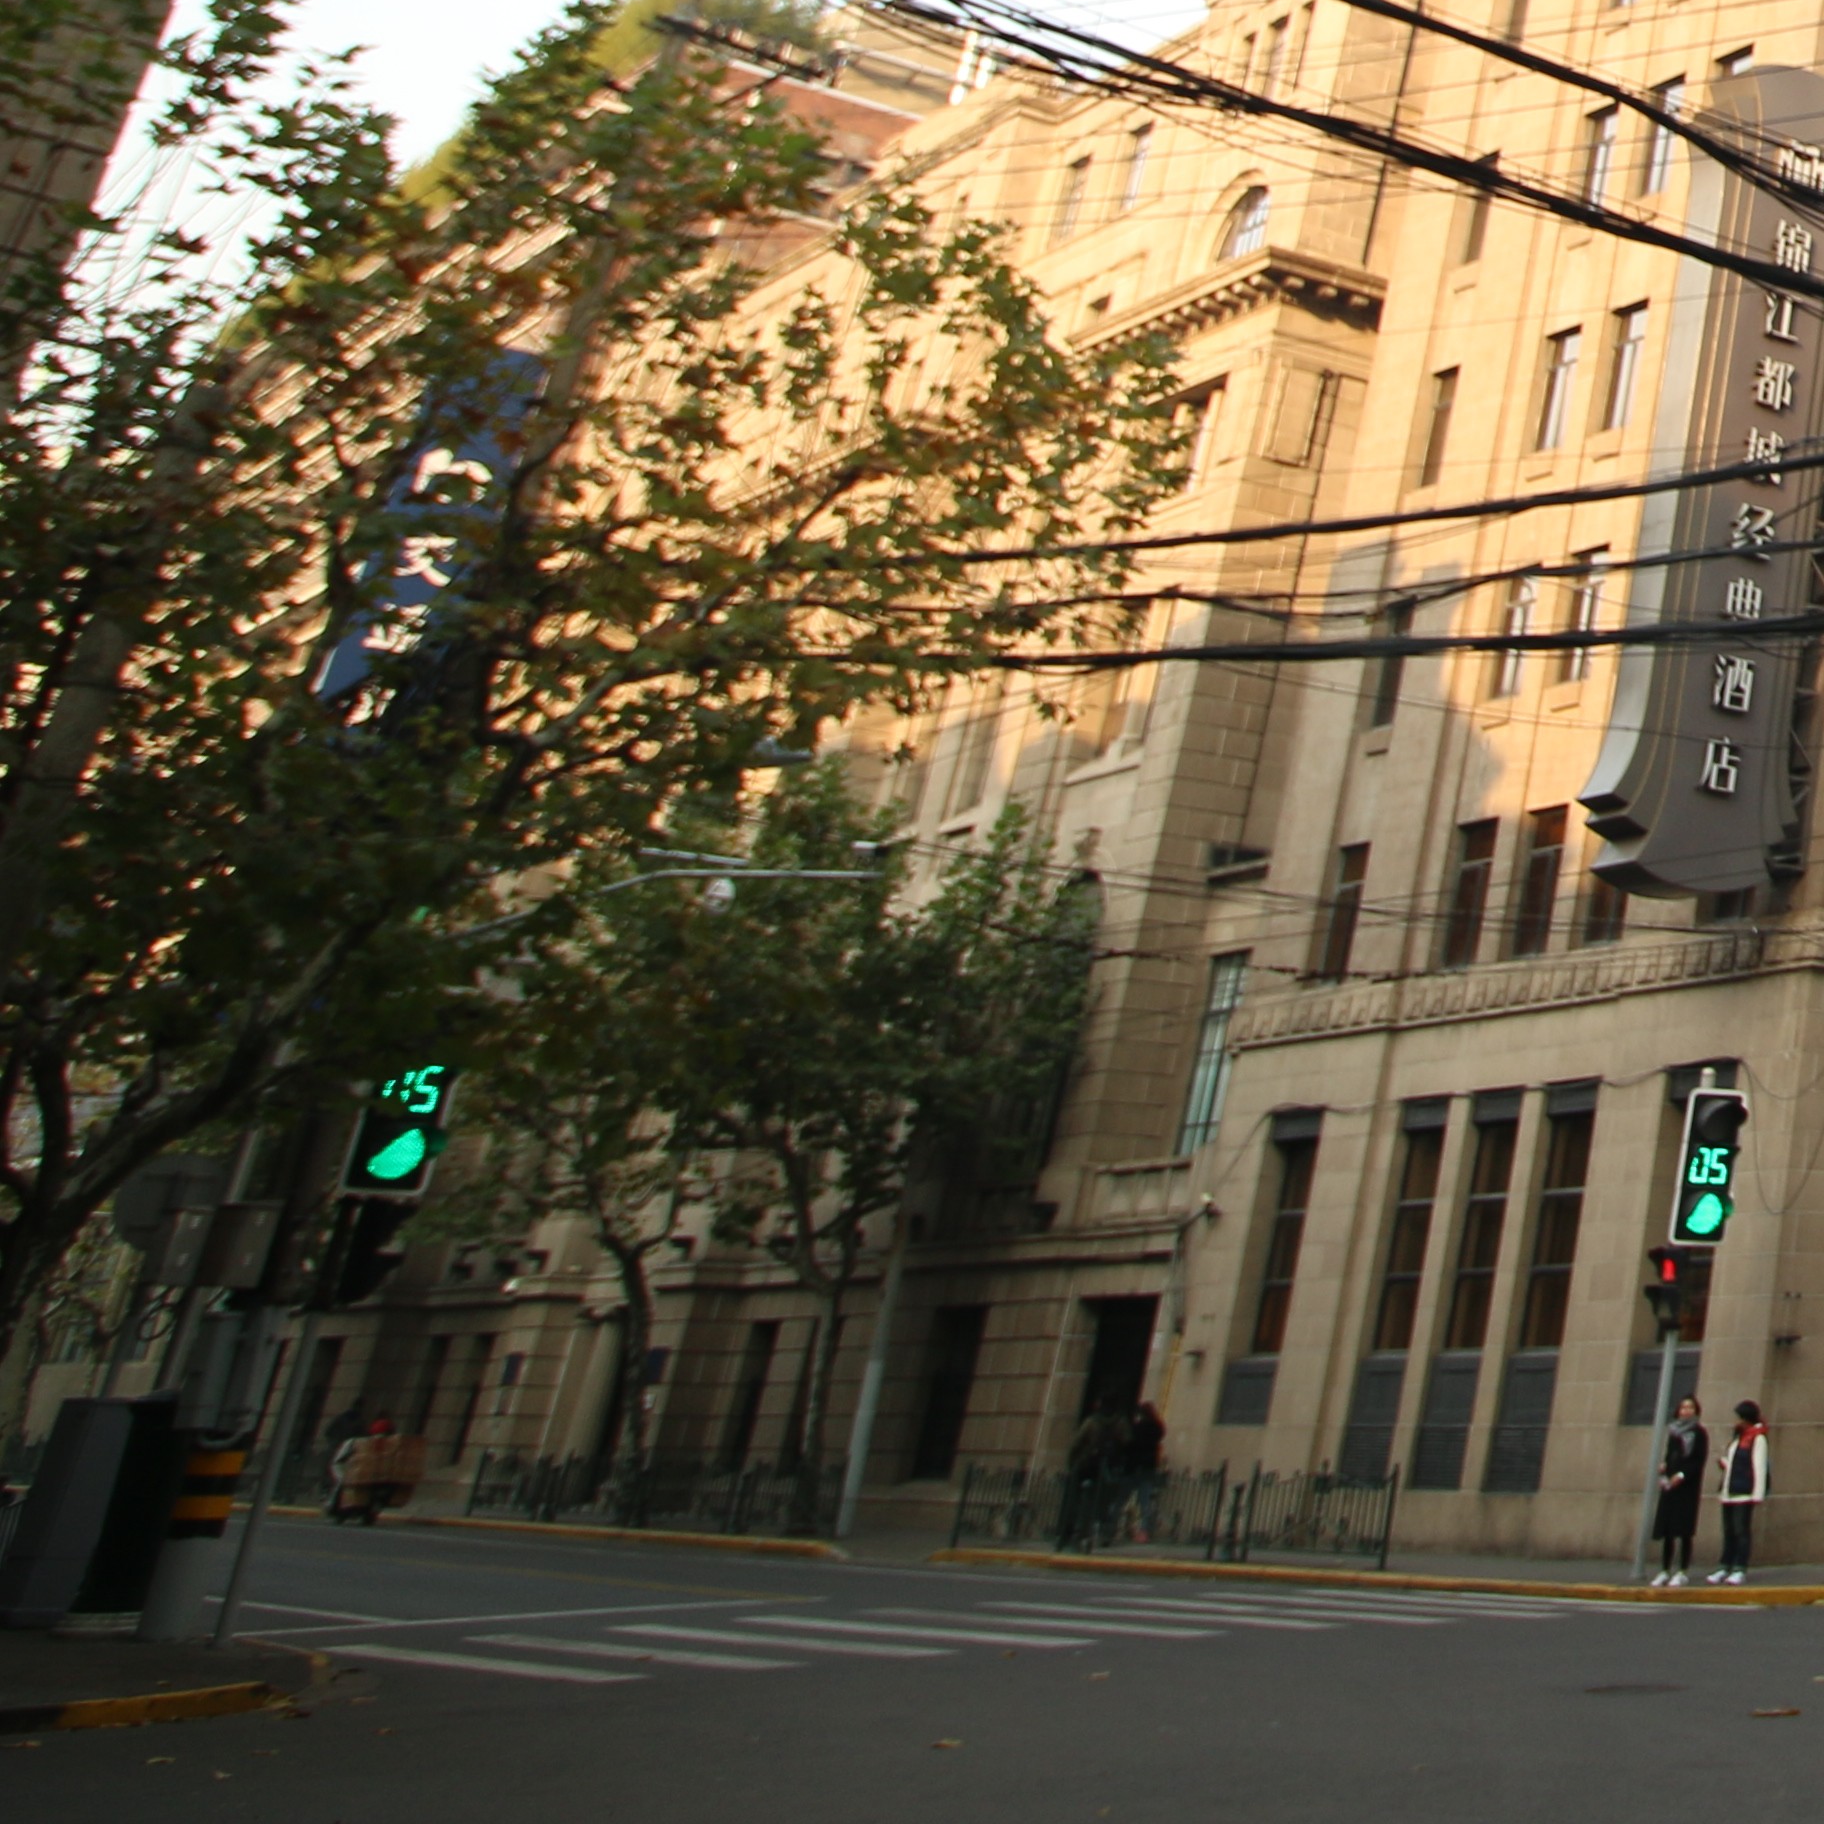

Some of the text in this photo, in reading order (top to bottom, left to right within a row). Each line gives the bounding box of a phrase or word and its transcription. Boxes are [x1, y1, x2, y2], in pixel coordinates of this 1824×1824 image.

[1699, 219, 1813, 794] 锦江都城经典酒店
[1688, 1146, 1729, 1185] 05
